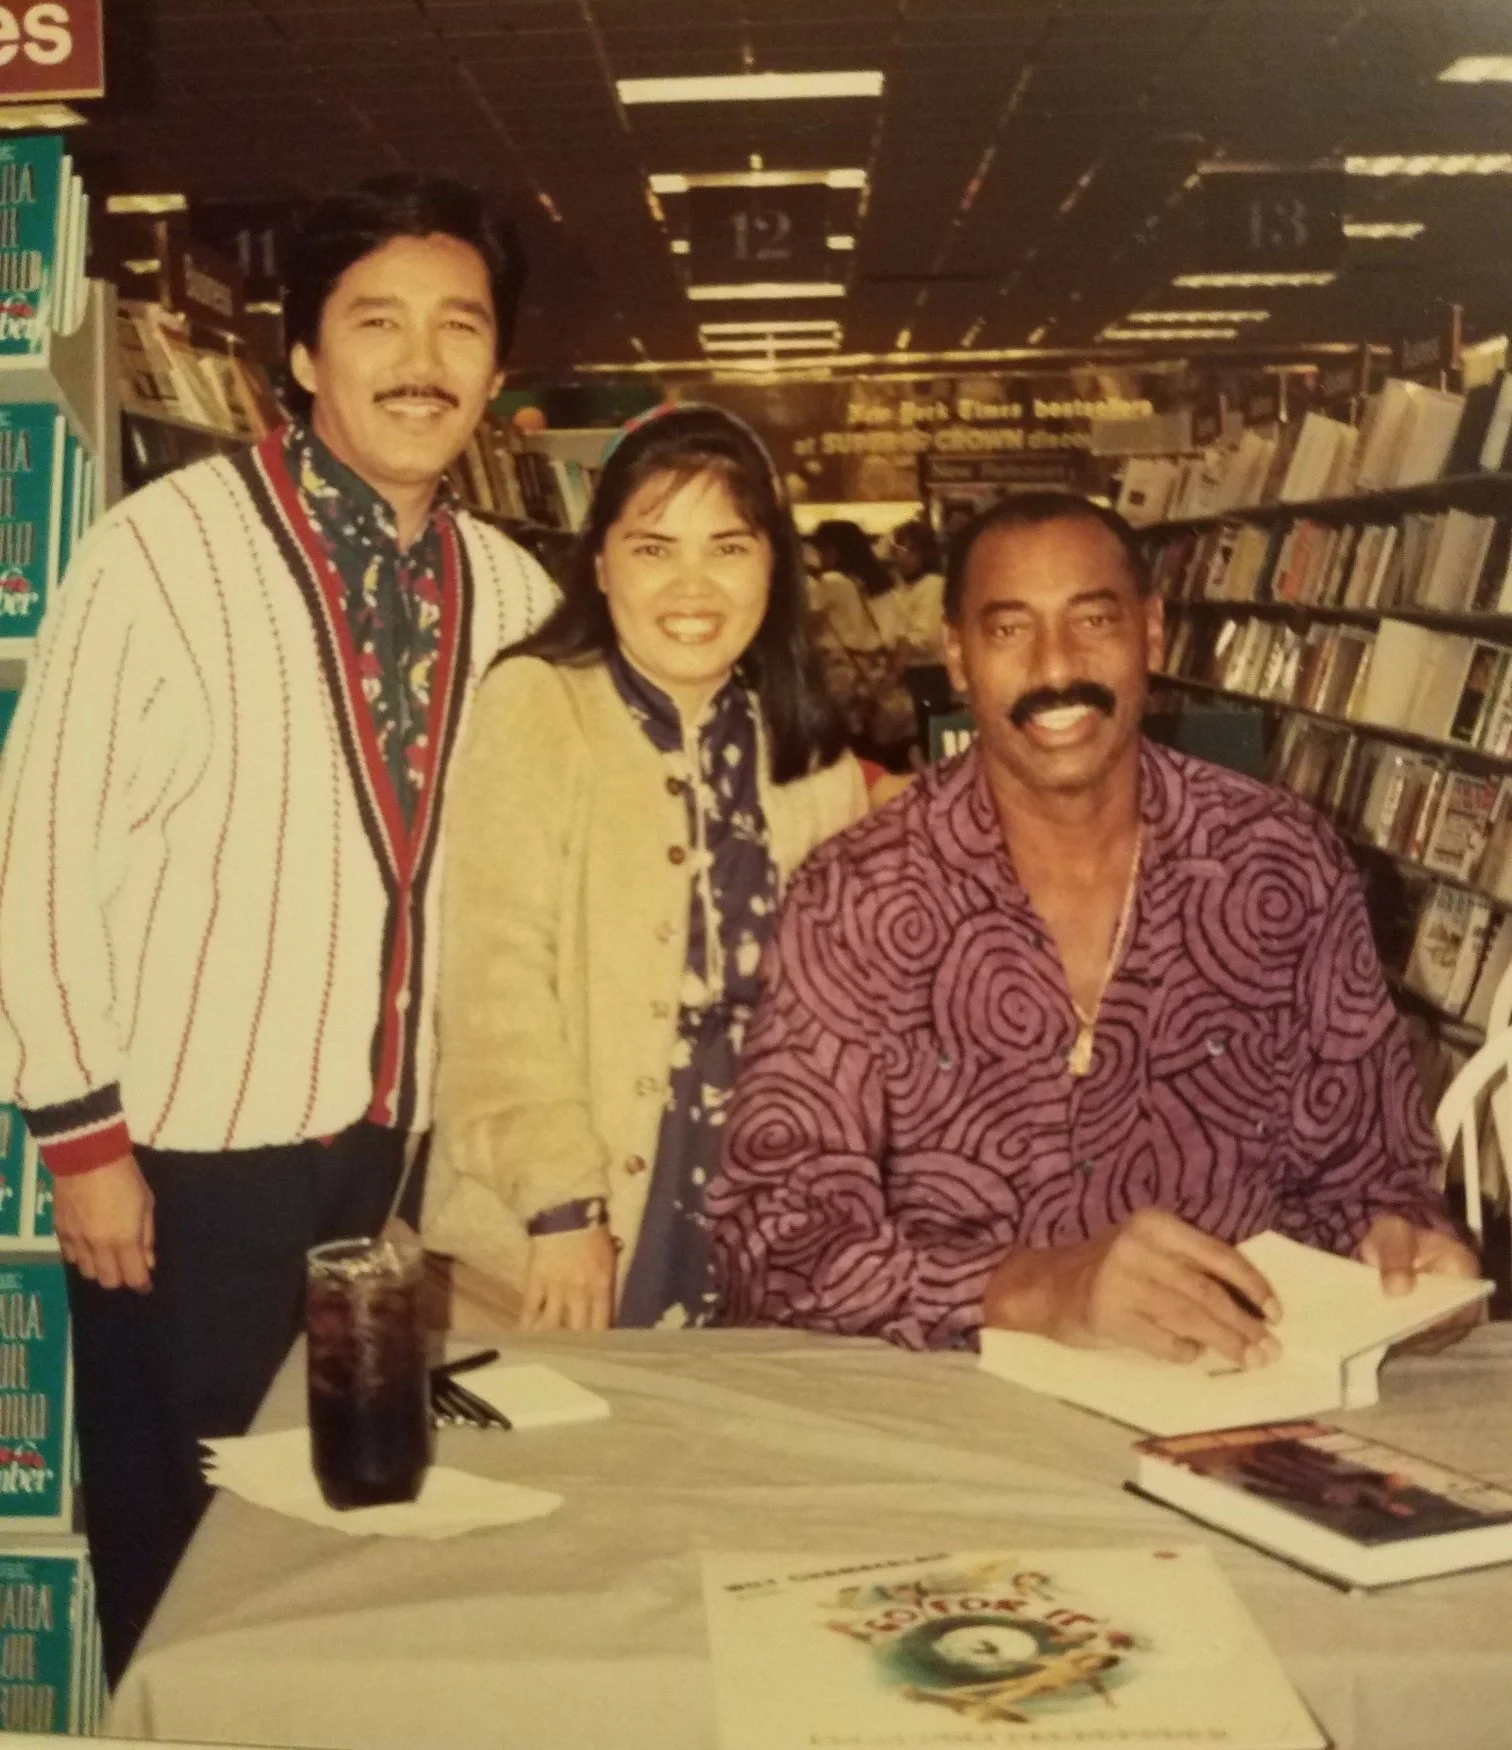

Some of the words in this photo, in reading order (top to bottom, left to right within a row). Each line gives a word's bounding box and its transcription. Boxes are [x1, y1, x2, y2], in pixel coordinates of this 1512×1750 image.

[732, 209, 793, 260] 12
[1247, 198, 1308, 248] 13
[237, 229, 276, 277] 11
[899, 400, 948, 425] York
[957, 397, 1022, 421] Times
[1033, 397, 1153, 420] bestsellers
[794, 437, 817, 455] at
[934, 429, 1023, 450] CROWN
